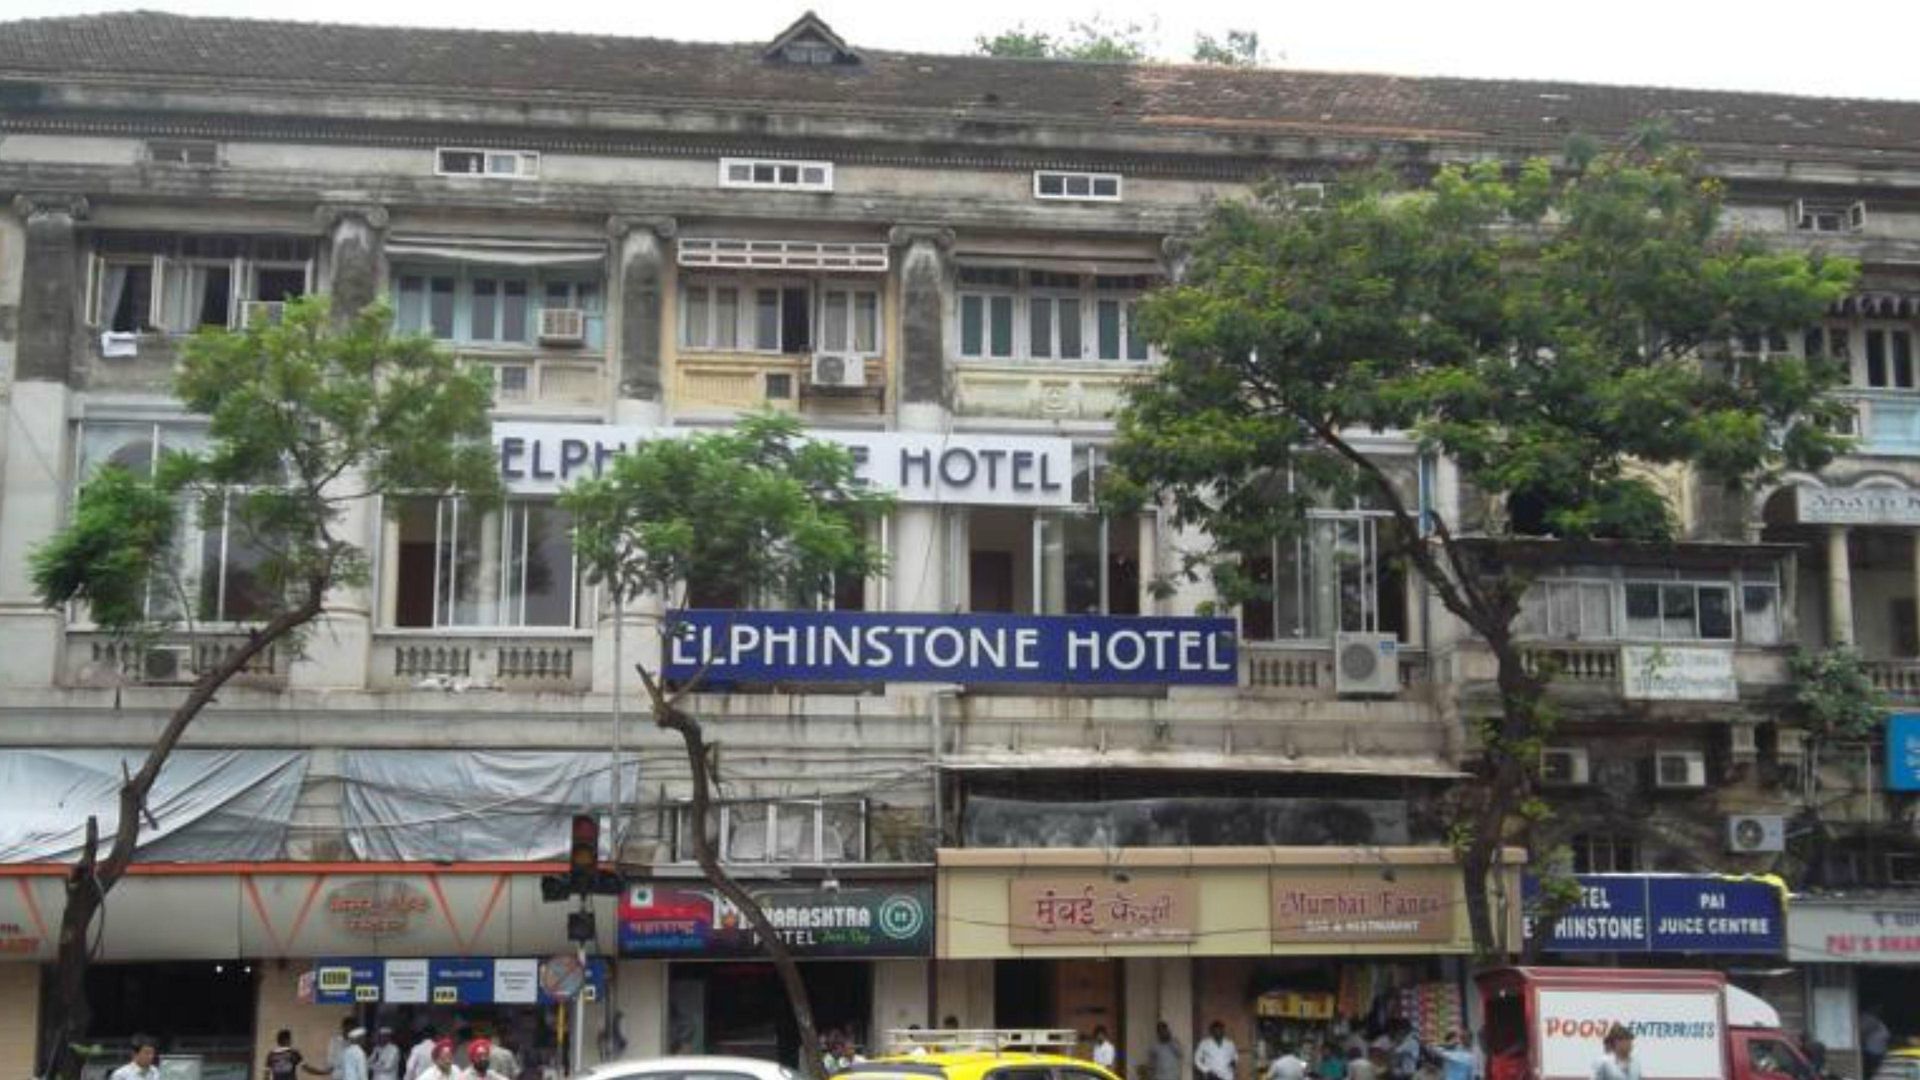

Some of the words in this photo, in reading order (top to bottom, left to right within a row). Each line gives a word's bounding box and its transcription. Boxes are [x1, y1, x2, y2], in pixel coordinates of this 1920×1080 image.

[901, 447, 1062, 491] HOTEL
[671, 623, 1040, 668] ELPHINSTONE
[1066, 629, 1231, 671] HOTEL
[1280, 891, 1365, 918] Mumbai
[1700, 893, 1726, 910] PAI
[1523, 916, 1645, 940] EHINSTONE
[1658, 917, 1704, 935] JUICE
[1708, 917, 1770, 935] CENTRE
